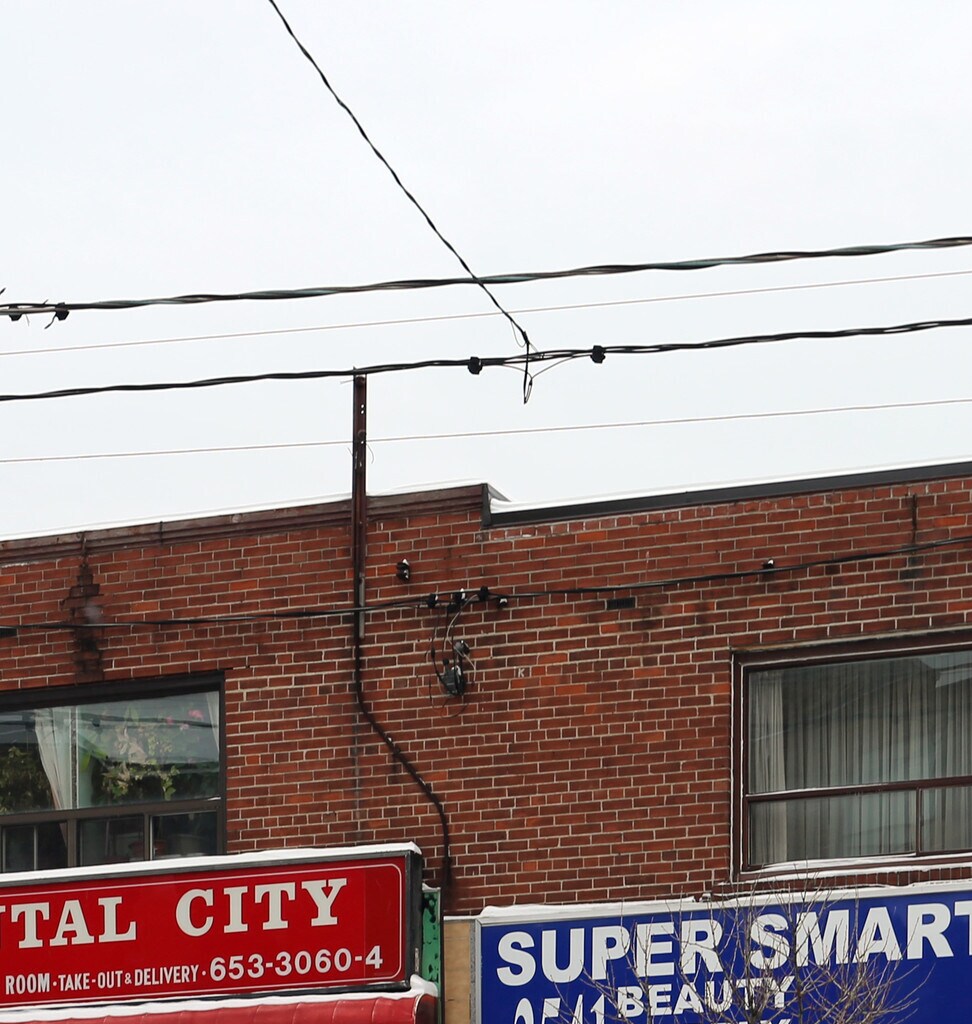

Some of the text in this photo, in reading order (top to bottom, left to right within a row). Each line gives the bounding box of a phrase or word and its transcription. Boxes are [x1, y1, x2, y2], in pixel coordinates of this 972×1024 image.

[0, 878, 348, 949] TAL CITY
[5, 973, 50, 995] ROOM
[134, 965, 199, 987] DELIVERY
[209, 945, 383, 982] 653-3060-4
[497, 919, 724, 986] SUPER
[617, 976, 795, 1018] BEAUTY
